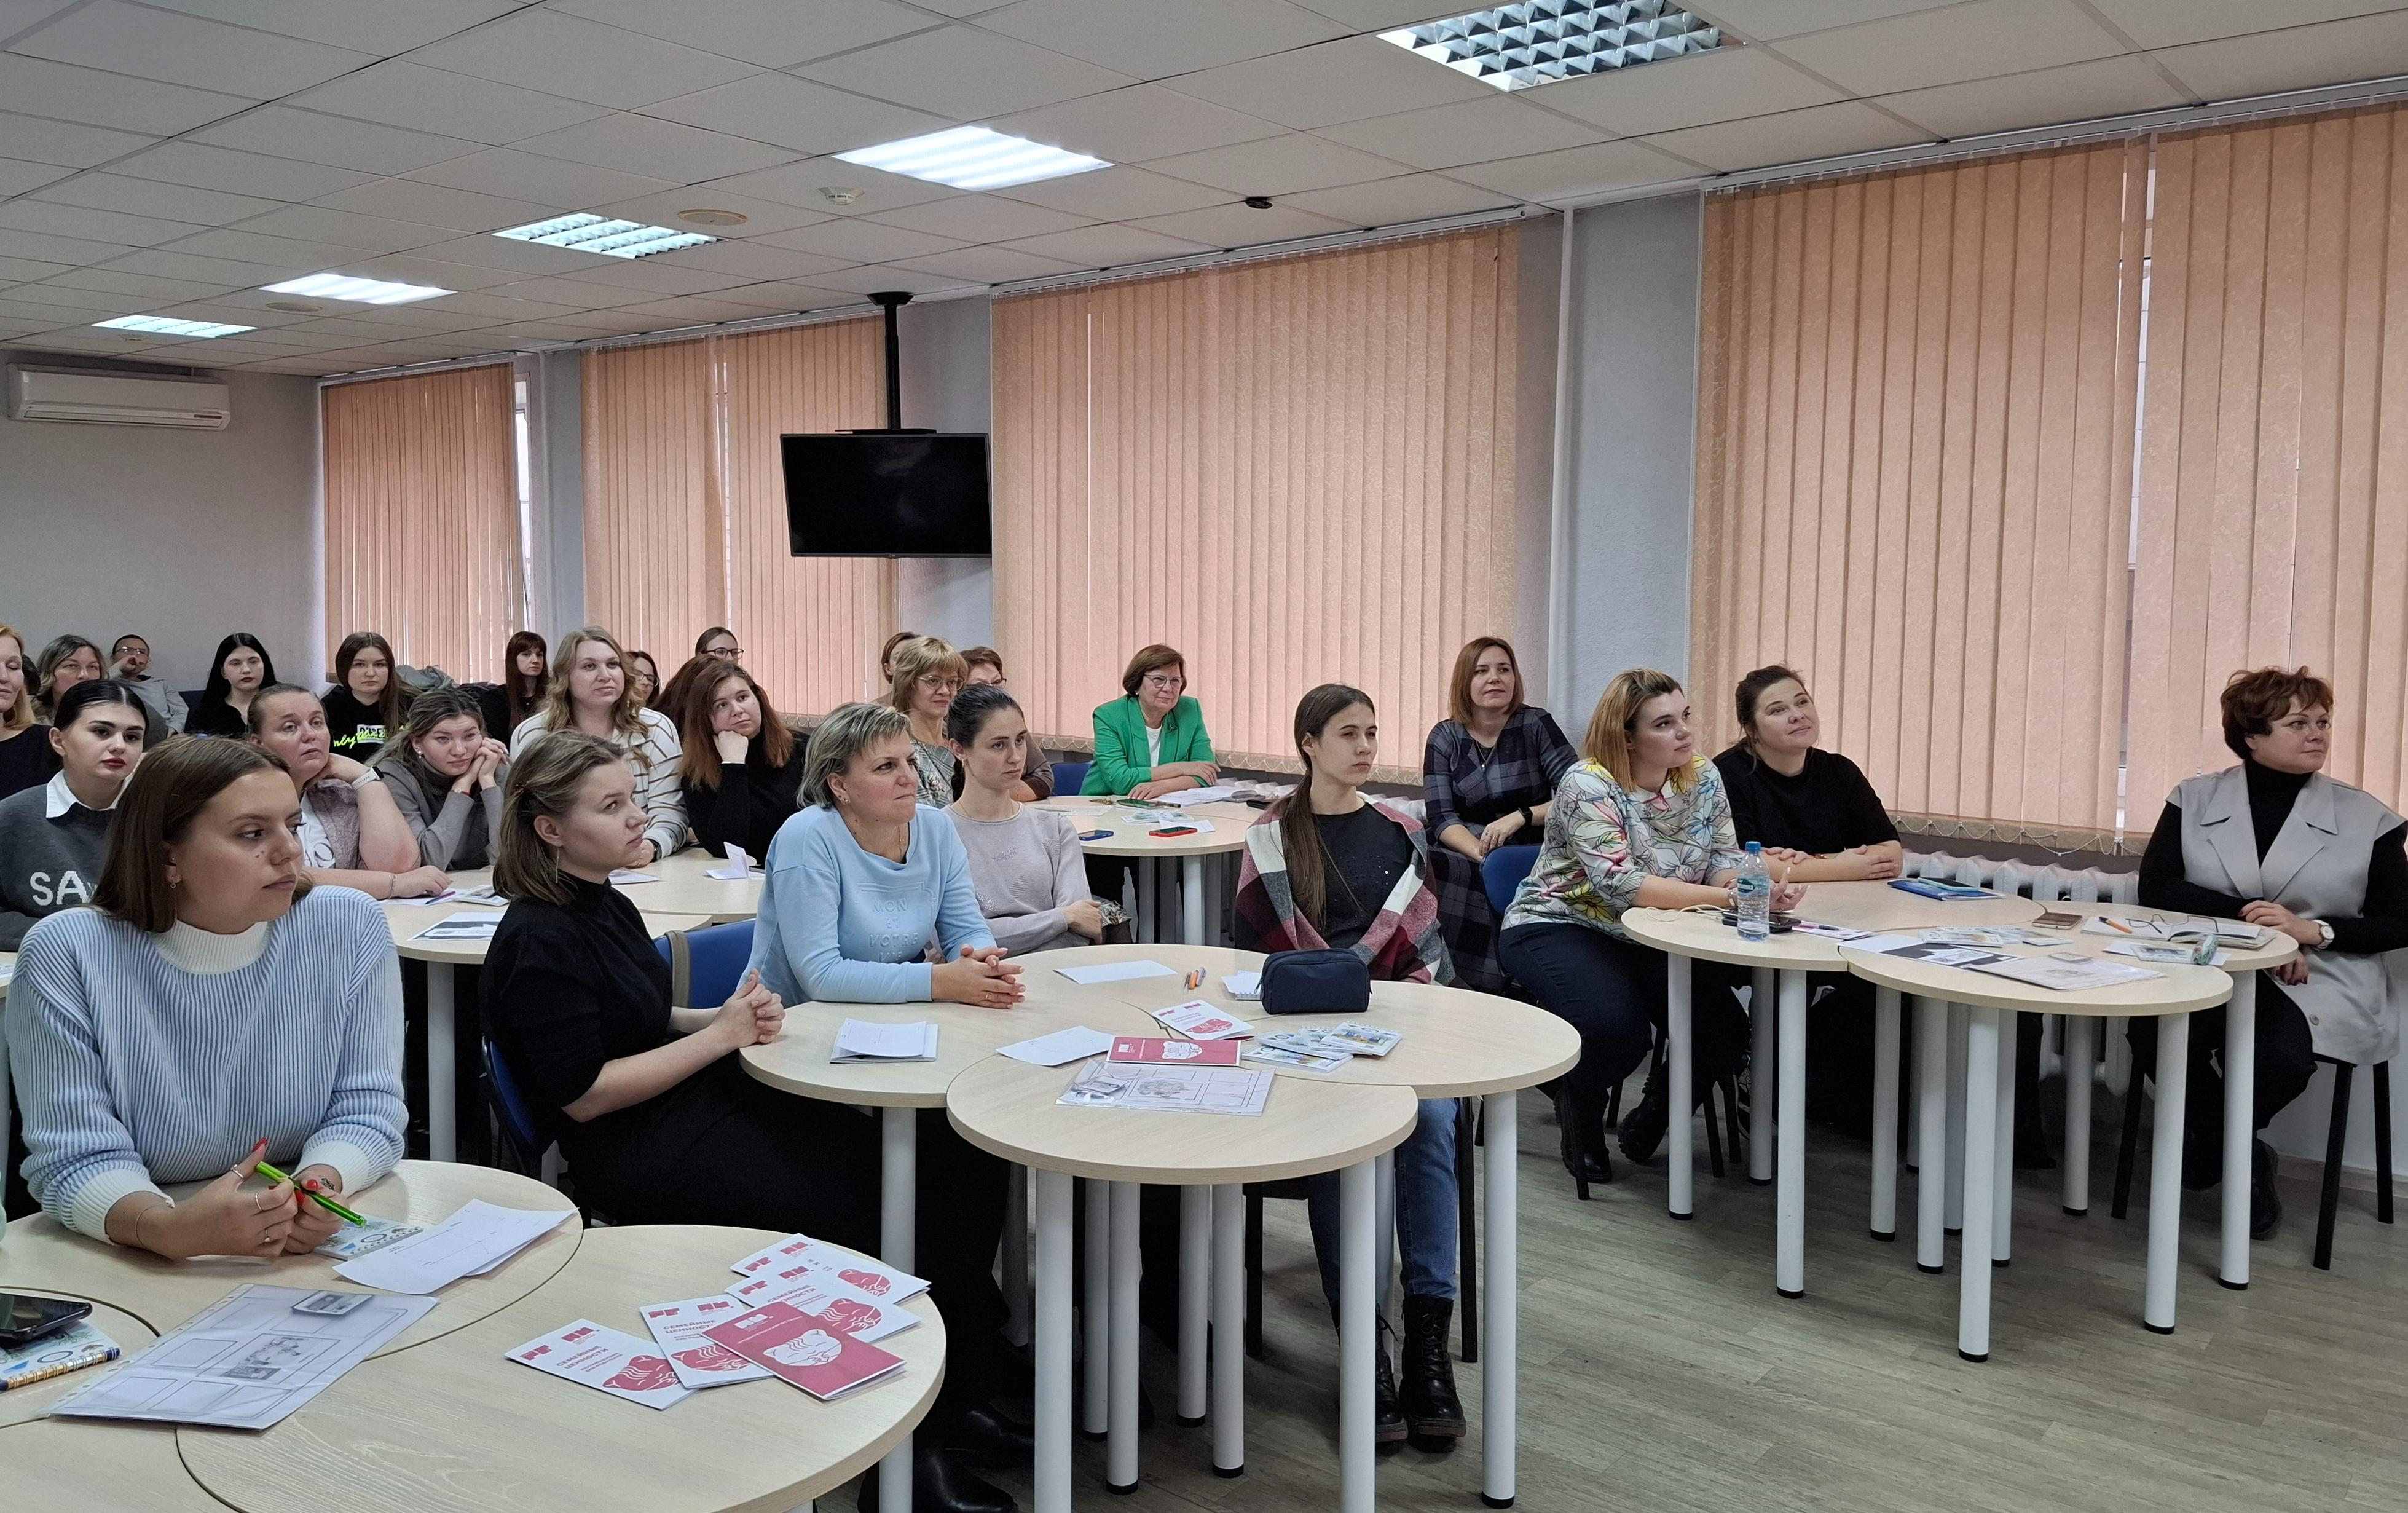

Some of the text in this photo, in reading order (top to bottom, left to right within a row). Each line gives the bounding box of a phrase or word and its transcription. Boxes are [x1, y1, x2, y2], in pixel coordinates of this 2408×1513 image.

[872, 898, 907, 912] MON
[869, 932, 918, 947] VOTRE
[783, 1288, 817, 1302] ННОСТИ
[663, 1319, 716, 1330] СЕМЕЙНЫЕ
[665, 1324, 714, 1334] ЦЕННОСТ
[556, 1345, 602, 1367] СЕМЕЙНЫЕ
[564, 1348, 609, 1370] ЦЕННОСТИ
